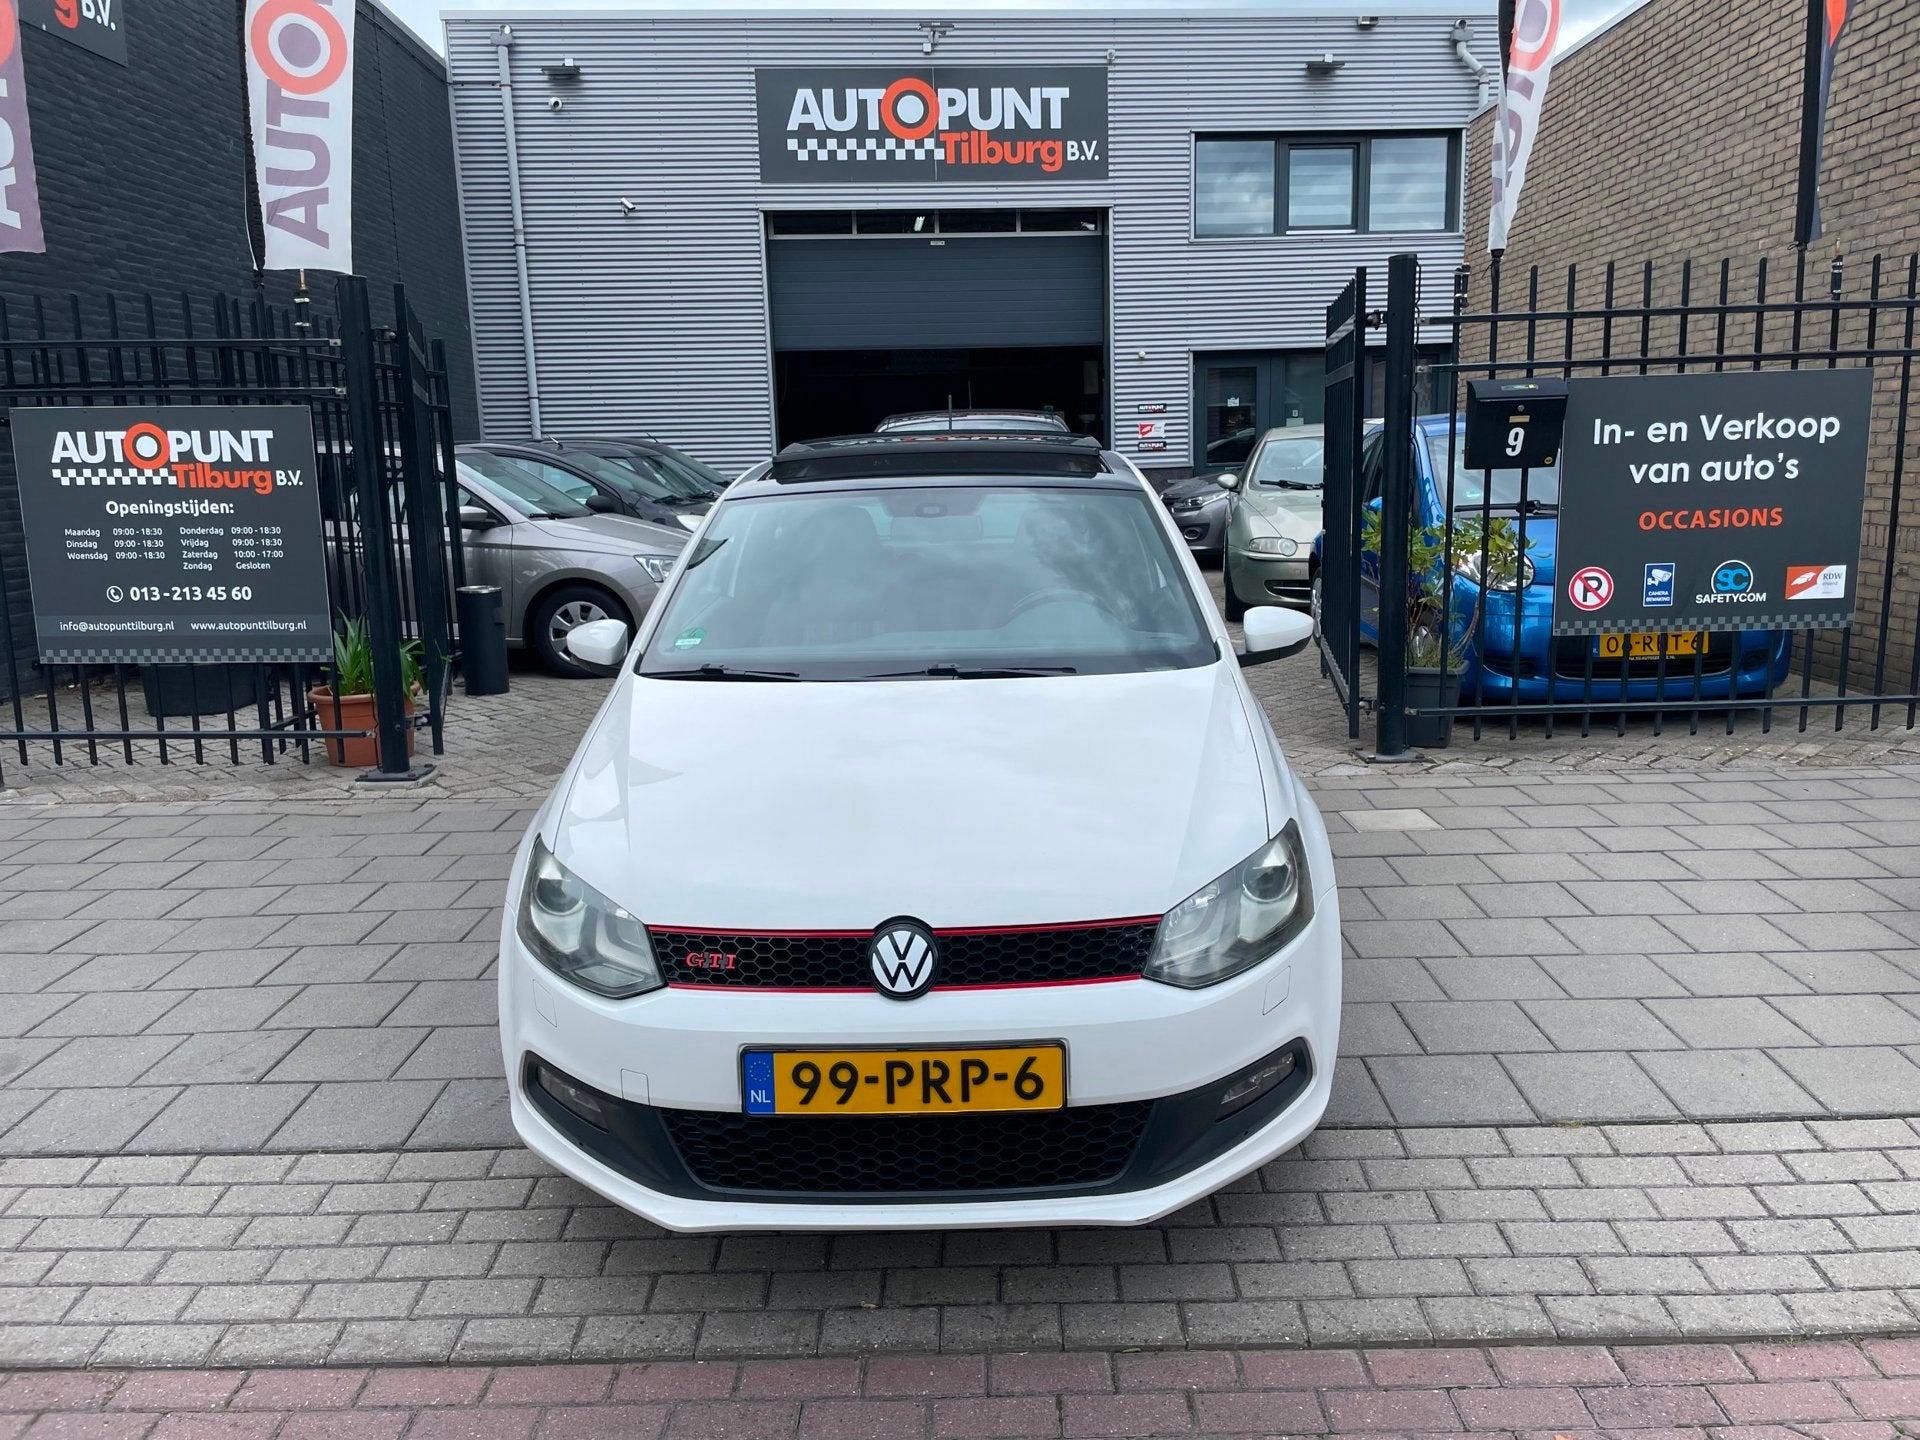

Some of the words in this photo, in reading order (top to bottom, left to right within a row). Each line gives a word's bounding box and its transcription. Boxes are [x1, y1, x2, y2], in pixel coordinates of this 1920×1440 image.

[786, 77, 1070, 140] AUTOPUNT
[250, 0, 348, 250] AUTO
[939, 130, 1063, 172] Tilburg
[1066, 140, 1100, 161] B.V.
[1593, 418, 1635, 445] In-
[1646, 421, 1688, 443] en
[1700, 412, 1841, 443] Verkoop
[51, 422, 273, 470] AUTOPUNT
[1505, 427, 1525, 457] 9
[1629, 462, 1690, 484] van
[1700, 452, 1799, 482] auto's
[171, 462, 273, 495] Tilburg
[276, 469, 304, 486] B.V.
[105, 499, 235, 518] Openingstijden:
[1638, 507, 1783, 531] OCCASIONS
[64, 528, 101, 538] Maandag
[112, 527, 135, 536] 09:00
[141, 527, 163, 536] 18:30
[179, 527, 224, 536] Donderdag
[230, 526, 254, 535] 09:00
[259, 526, 282, 535] 18:30
[66, 540, 98, 550] Dinsdag
[114, 539, 136, 548] 09:00
[143, 539, 164, 548] 18:30
[180, 539, 209, 548] Vrijdag
[232, 538, 255, 547] 09:00
[260, 538, 283, 547] 18:30
[67, 552, 108, 561] Woensdag
[115, 551, 138, 560] 09:00
[143, 551, 166, 560] 18:30
[182, 551, 218, 560] Zaterdag
[233, 550, 256, 558] 10:00
[261, 550, 284, 558] 17:00
[183, 562, 213, 571] Zondag
[235, 561, 271, 570] Gesloten
[1823, 572, 1843, 581] RDW
[206, 586, 227, 601] 45
[231, 586, 252, 601] 60
[1695, 592, 1766, 604] SAFETYCOM
[60, 621, 175, 633] info@autopunttilburg.nl
[190, 620, 307, 632] www.autopunttilburg.nl
[686, 952, 736, 969] GTI
[750, 1089, 771, 1103] NL
[791, 1056, 1044, 1105] 99-PRP-6
